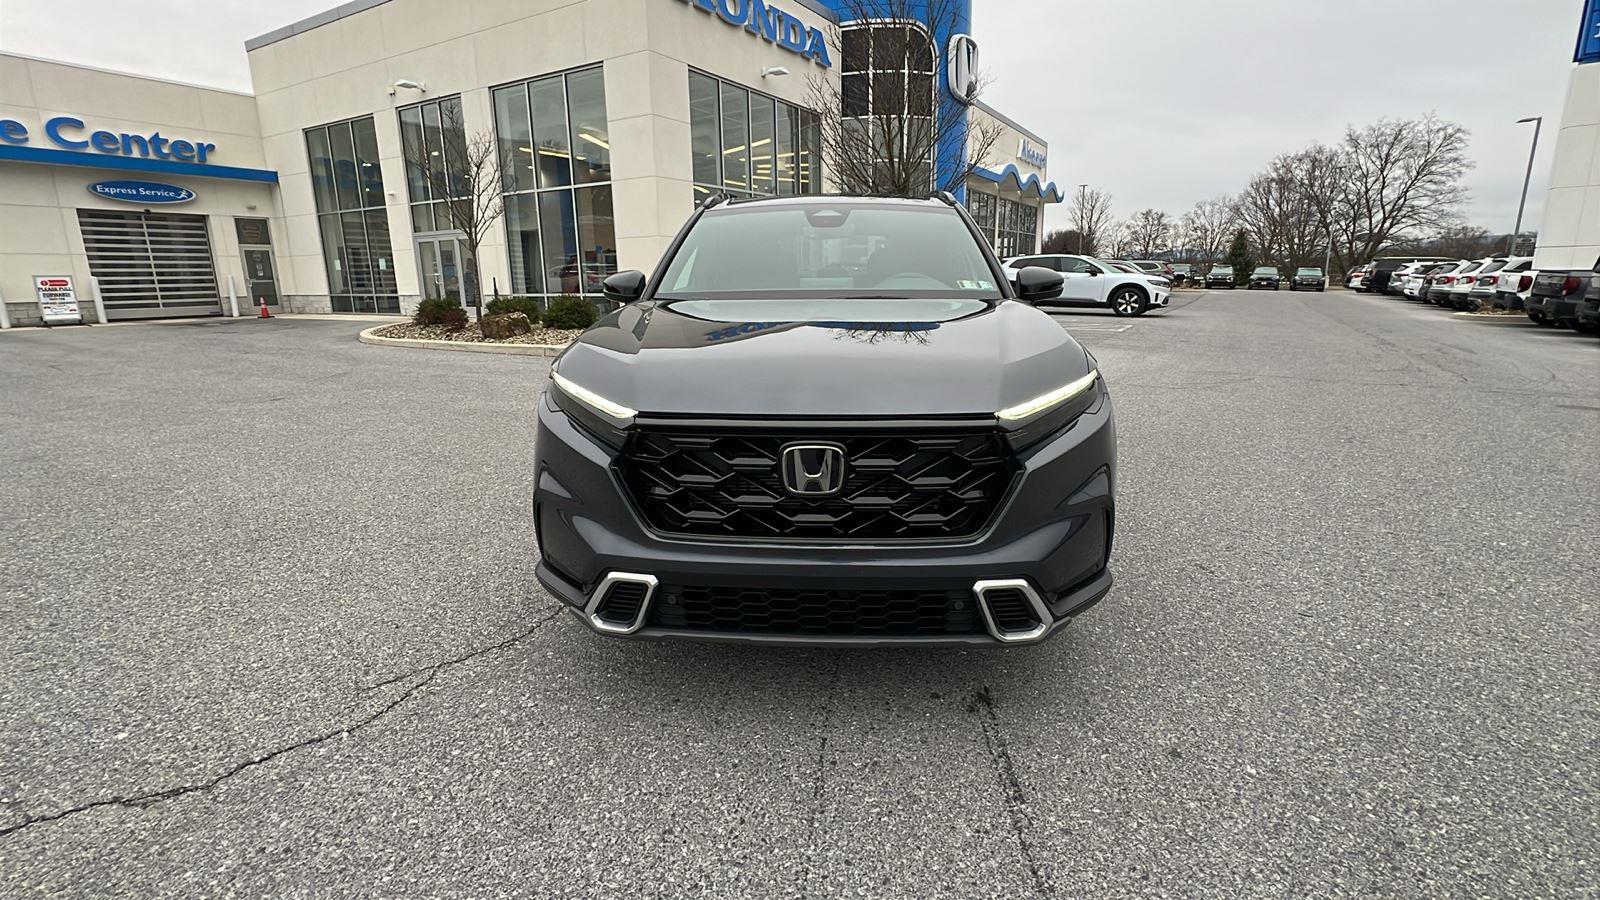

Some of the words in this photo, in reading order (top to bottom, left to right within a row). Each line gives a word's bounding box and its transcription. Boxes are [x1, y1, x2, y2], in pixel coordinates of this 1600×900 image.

[674, 0, 832, 68] ONDA
[45, 116, 216, 162] Center
[96, 184, 137, 195] Express
[138, 187, 176, 197] Service
